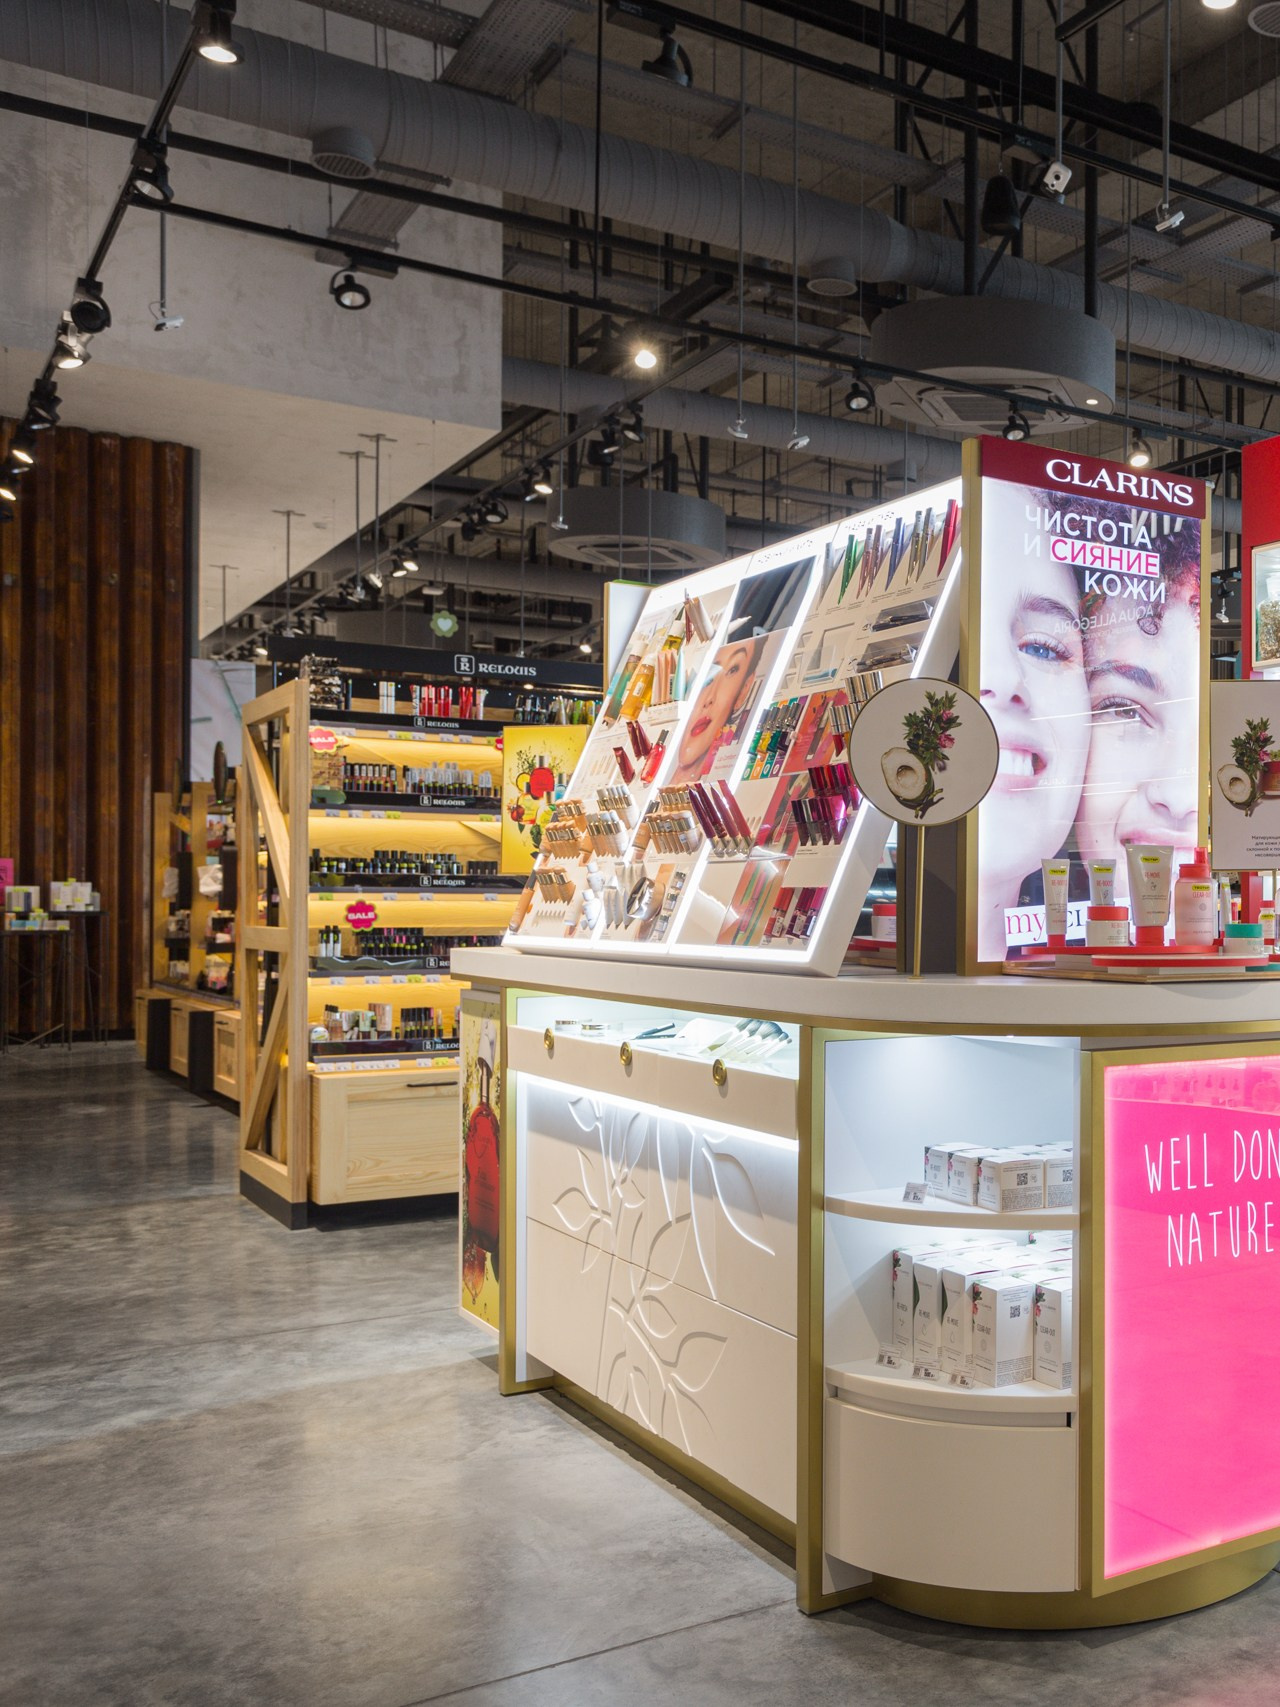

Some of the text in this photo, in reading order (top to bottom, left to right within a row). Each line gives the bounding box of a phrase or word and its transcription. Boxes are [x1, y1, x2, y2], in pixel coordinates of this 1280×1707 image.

[1046, 458, 1194, 508] CLARINS
[1025, 505, 1153, 549] ЧИСТОТА
[1024, 533, 1159, 577] И СИЯНИЕ
[1084, 570, 1167, 604] КОЖИ
[478, 662, 537, 677] RELOUIS
[347, 911, 375, 920] SALE
[1007, 912, 1046, 942] my
[1144, 1132, 1214, 1194] WELL
[1167, 1201, 1275, 1268] NATURE
